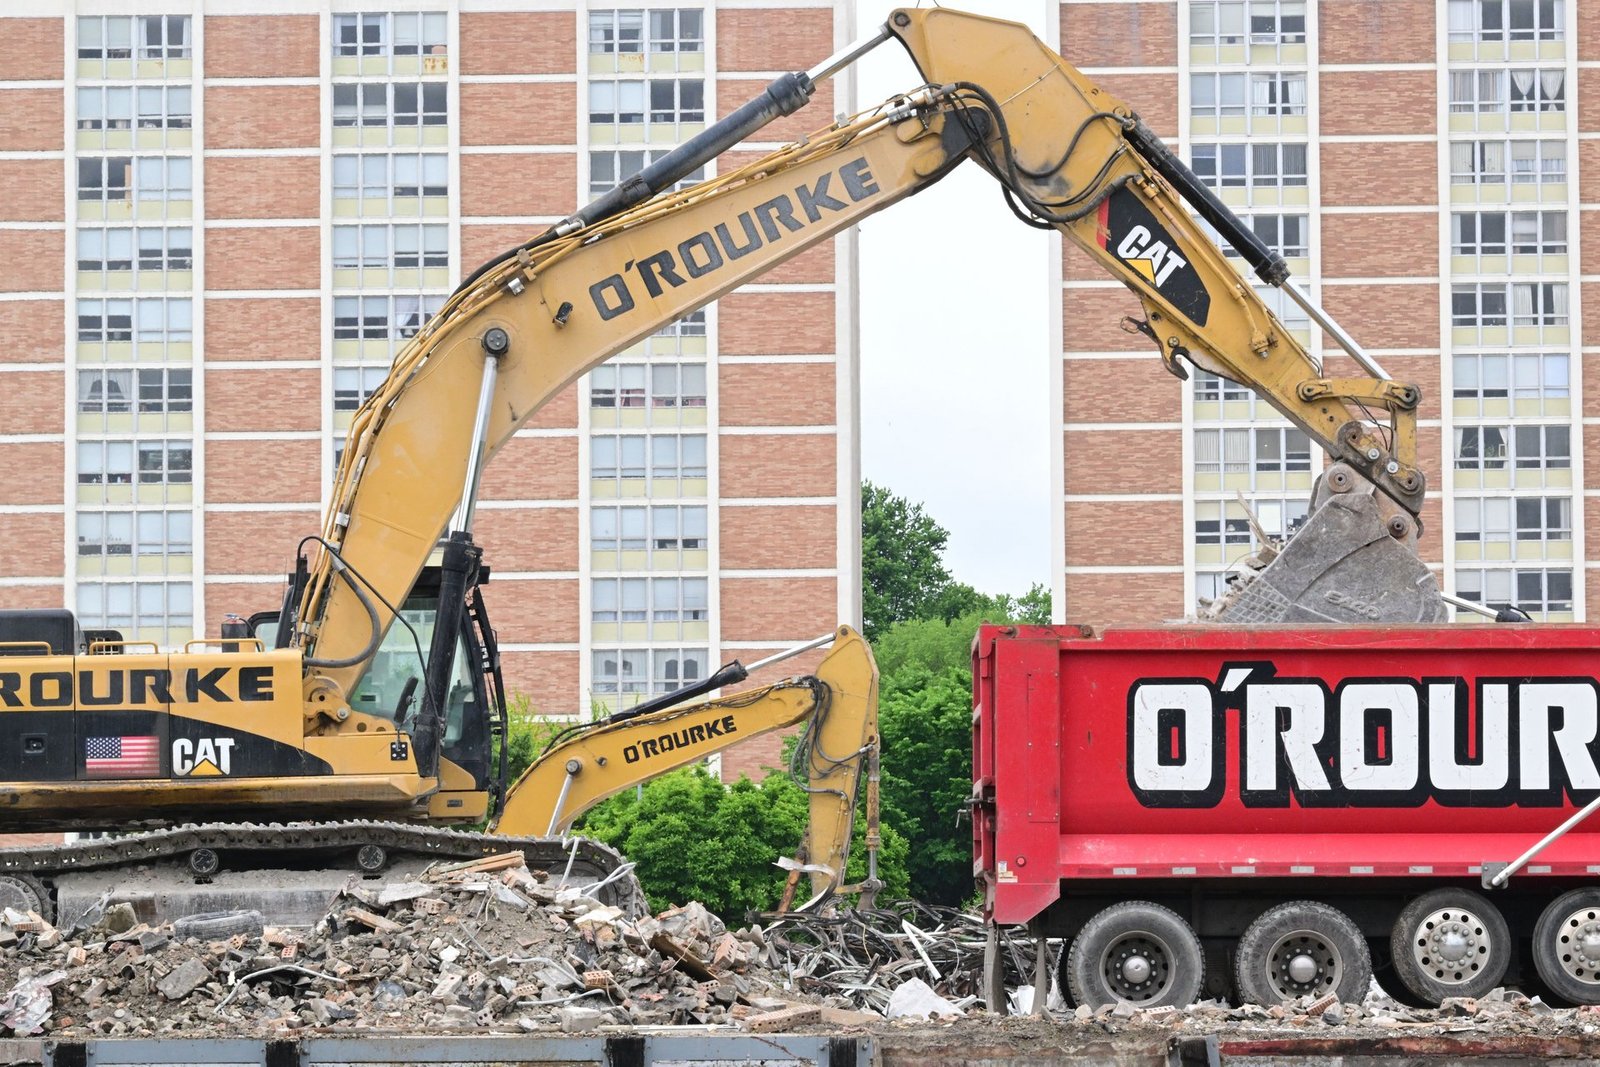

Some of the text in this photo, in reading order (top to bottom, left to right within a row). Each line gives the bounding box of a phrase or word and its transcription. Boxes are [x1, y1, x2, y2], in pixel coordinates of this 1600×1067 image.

[589, 156, 880, 321] O'ROURKE
[1117, 225, 1187, 288] CAT
[0, 667, 274, 707] ROURKE
[172, 738, 235, 776] CAT
[623, 715, 737, 764] O'ROURKE
